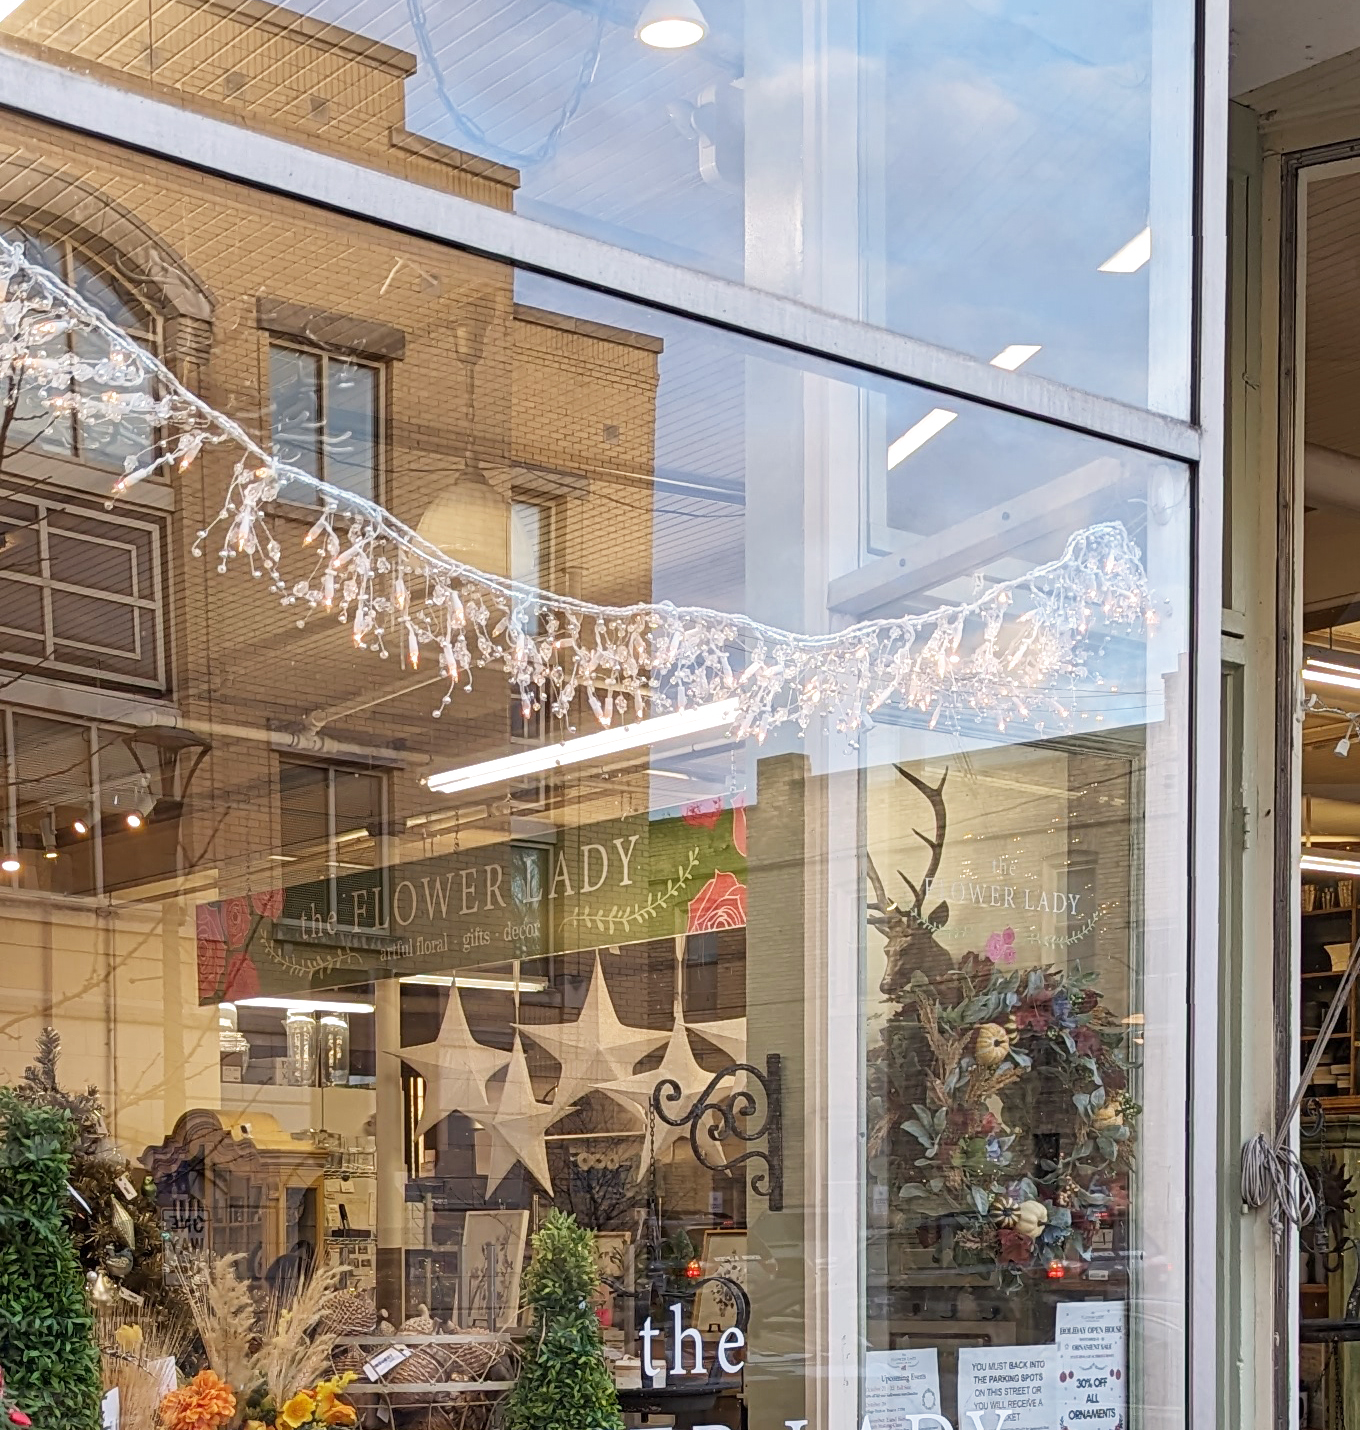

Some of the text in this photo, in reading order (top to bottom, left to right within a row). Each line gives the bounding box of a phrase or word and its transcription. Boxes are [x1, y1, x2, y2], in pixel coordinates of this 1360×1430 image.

[991, 856, 1017, 876] the
[299, 834, 641, 941] the FLOWER LADY
[1024, 888, 1081, 915] LADY
[379, 919, 541, 962] artful floral gifts decor
[639, 1302, 746, 1377] the
[972, 1359, 1046, 1372] YOU MUST BACK INTO
[973, 1372, 1044, 1385] THE PARKING SPOTS
[1075, 1377, 1108, 1389] 30% OFF
[974, 1385, 1042, 1397] ON THIS STREET OR
[973, 1398, 1044, 1411] YOU WILL RECEIVE A
[1085, 1393, 1100, 1404] ALL
[1068, 1407, 1117, 1421] ORNAMENTS
